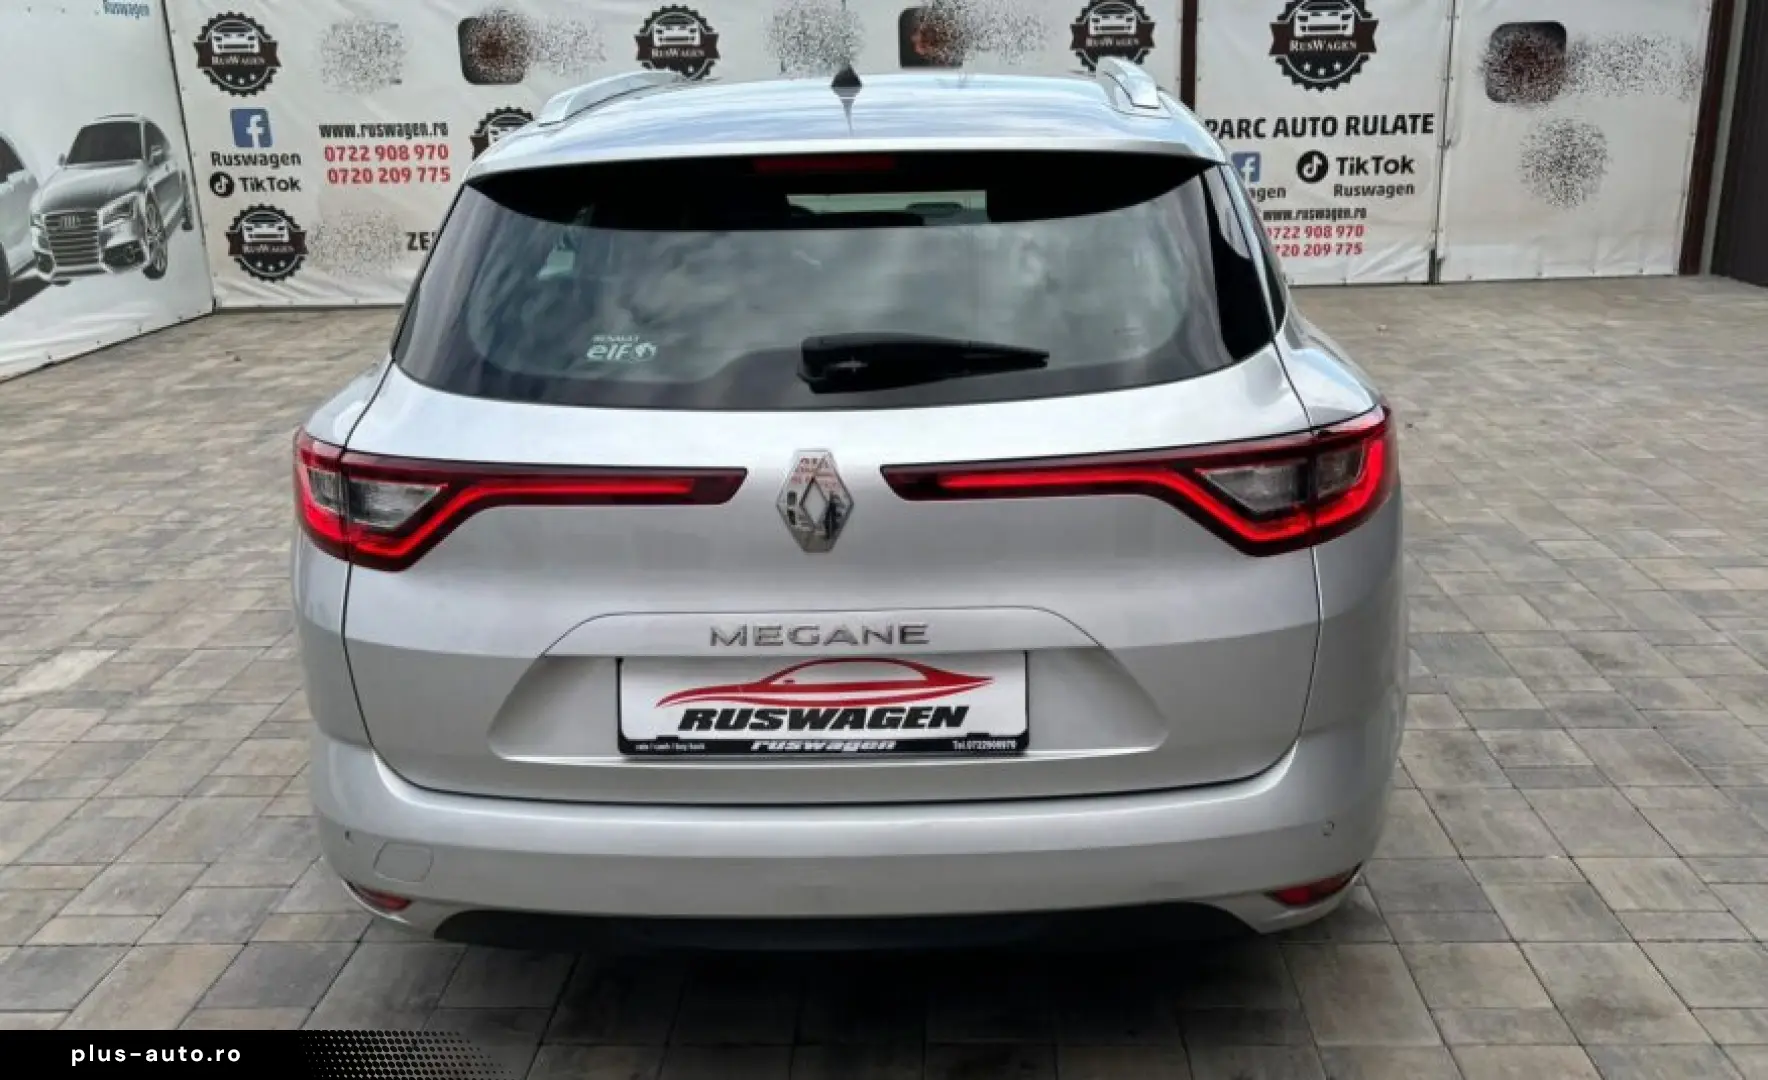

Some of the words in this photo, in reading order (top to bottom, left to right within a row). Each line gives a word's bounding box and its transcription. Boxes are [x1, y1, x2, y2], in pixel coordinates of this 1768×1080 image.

[1272, 116, 1338, 138] AUTO
[1345, 113, 1434, 136] RULATE
[210, 151, 302, 169] Ruswagen
[324, 146, 371, 162] 0722
[374, 146, 411, 162] 908
[413, 144, 449, 161] 970
[1336, 155, 1415, 177] TikTok
[238, 175, 302, 193] TikTok
[327, 168, 373, 184] 0720
[378, 167, 413, 183] 209
[417, 167, 450, 183] 775
[1334, 184, 1415, 198] Ruswagen
[1304, 225, 1333, 239] 908
[1336, 224, 1365, 238] 970
[406, 231, 437, 252] ZE
[1303, 243, 1332, 257] 209
[1335, 242, 1363, 256] 775
[709, 624, 930, 647] MEGANE
[678, 706, 969, 732] RUSWAGEN
[751, 740, 897, 753] ruswagen
